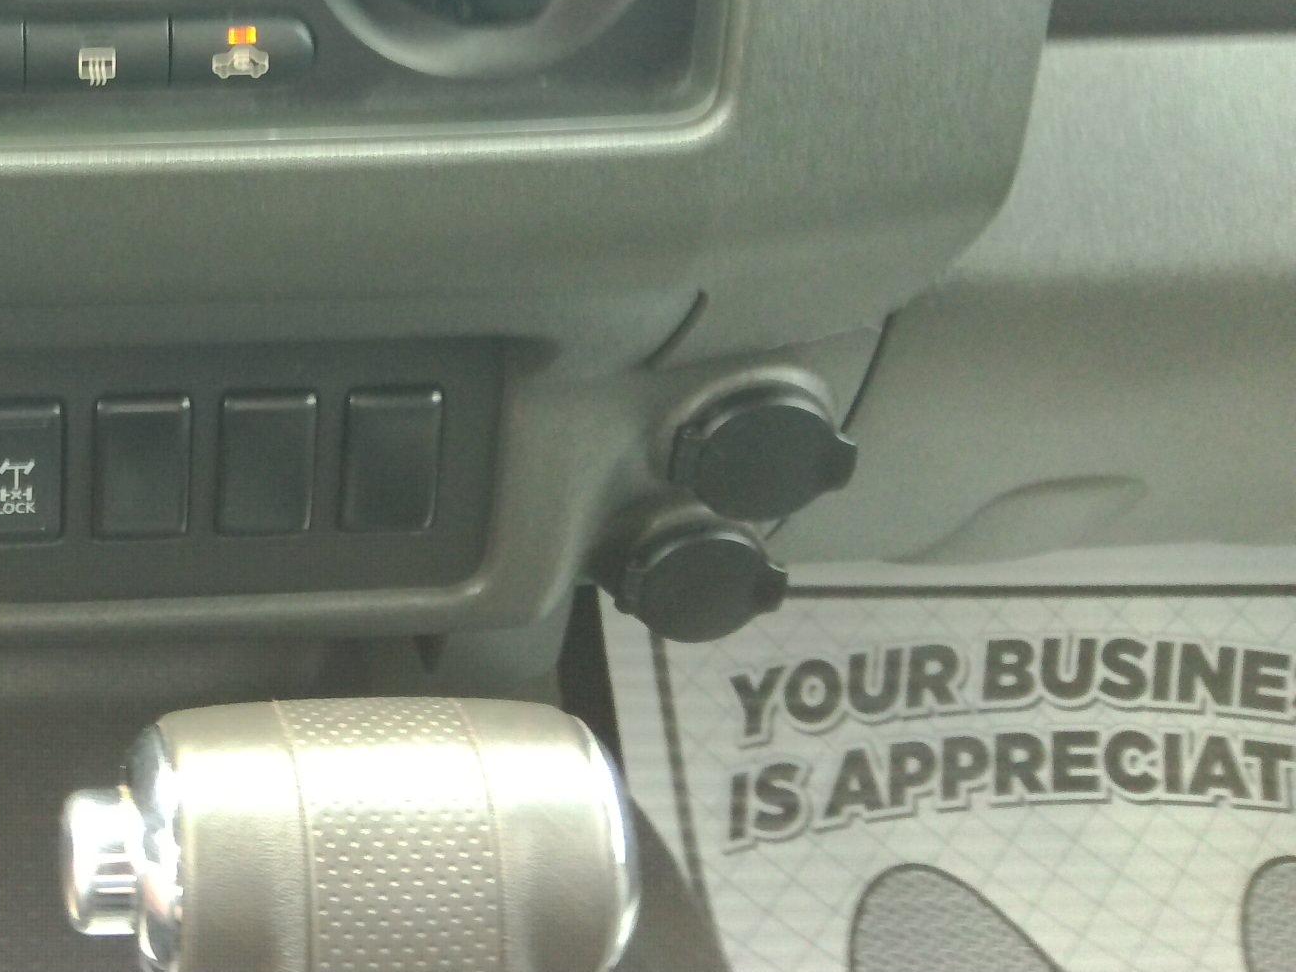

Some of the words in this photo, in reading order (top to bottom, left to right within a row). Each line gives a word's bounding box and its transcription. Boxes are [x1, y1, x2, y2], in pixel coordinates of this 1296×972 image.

[729, 642, 960, 738] YOUR
[982, 636, 1296, 715] BUSINE
[729, 761, 802, 843] IS
[824, 728, 1296, 820] APPRECIAT
